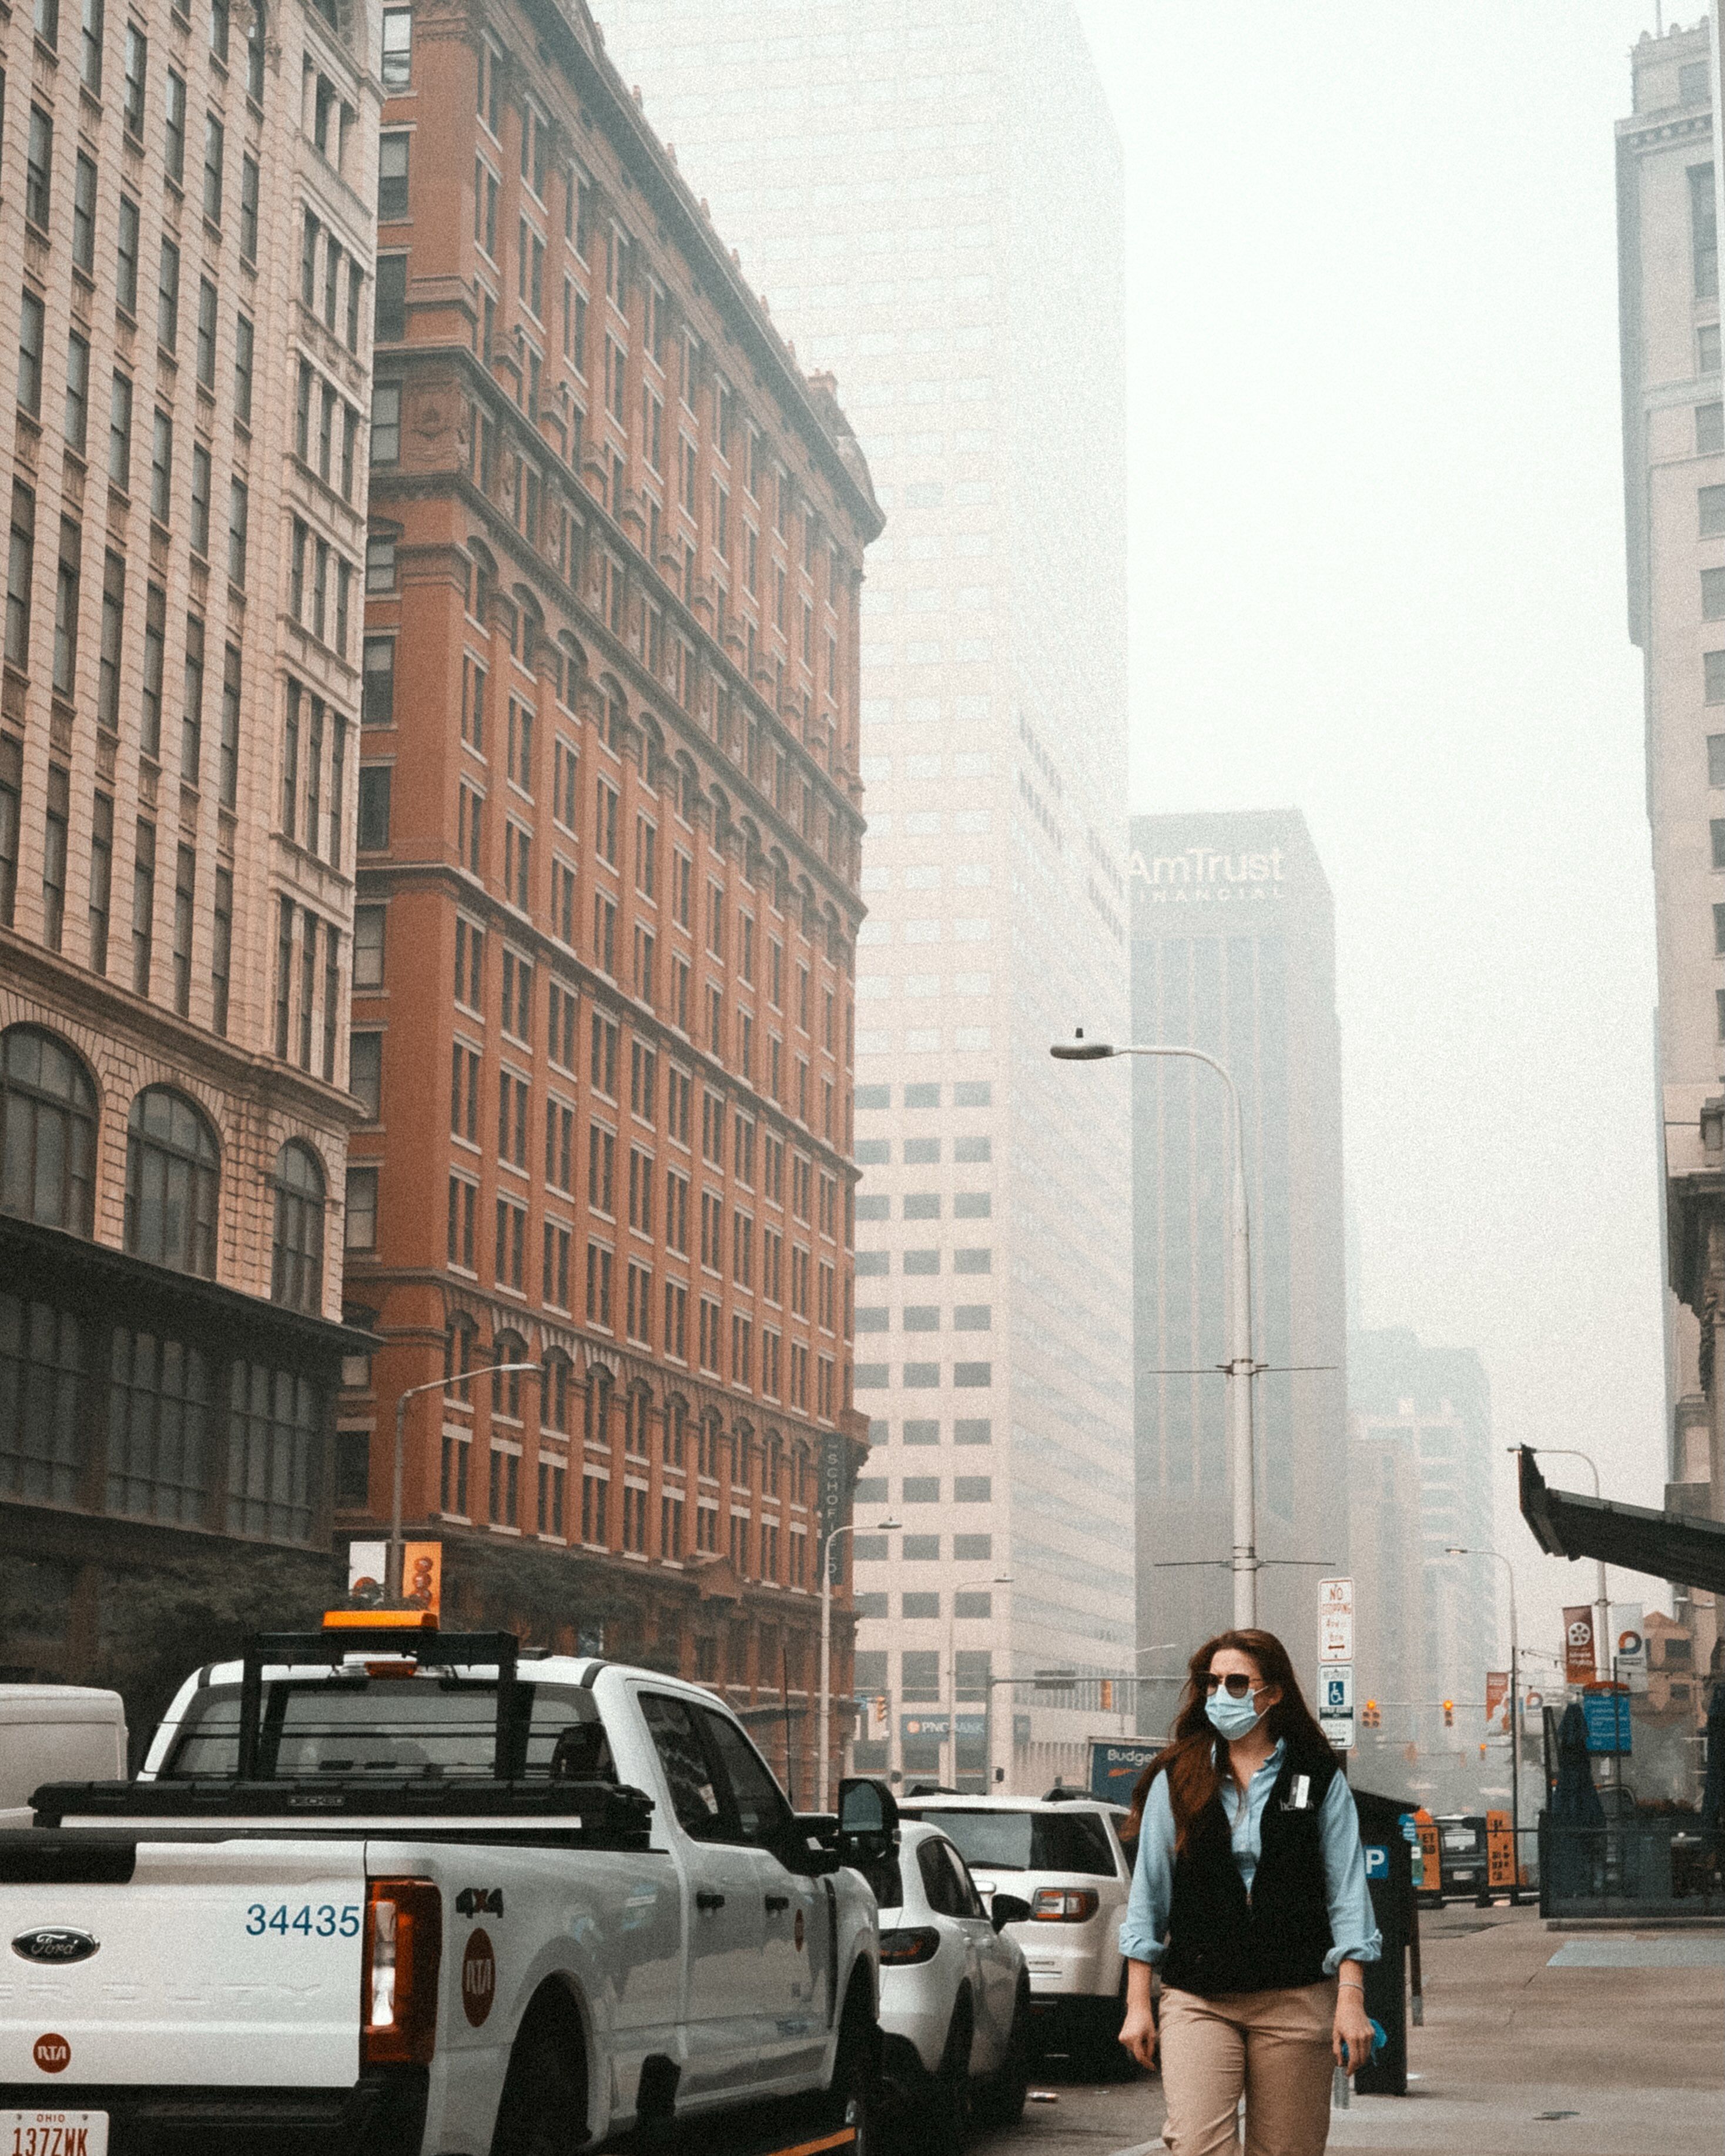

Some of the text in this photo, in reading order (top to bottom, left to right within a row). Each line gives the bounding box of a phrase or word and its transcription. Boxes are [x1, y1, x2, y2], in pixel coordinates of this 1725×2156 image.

[1128, 846, 1285, 885] AmTrust
[1329, 1587, 1343, 1601] NO
[922, 1722, 949, 1733] PNC
[1365, 1849, 1385, 1874] P
[246, 1904, 360, 1937] 34435
[31, 1933, 79, 1955] Ford
[36, 2045, 69, 2061] RTA
[36, 2114, 66, 2123] OHIO
[12, 2127, 89, 2156] 137ZWK
